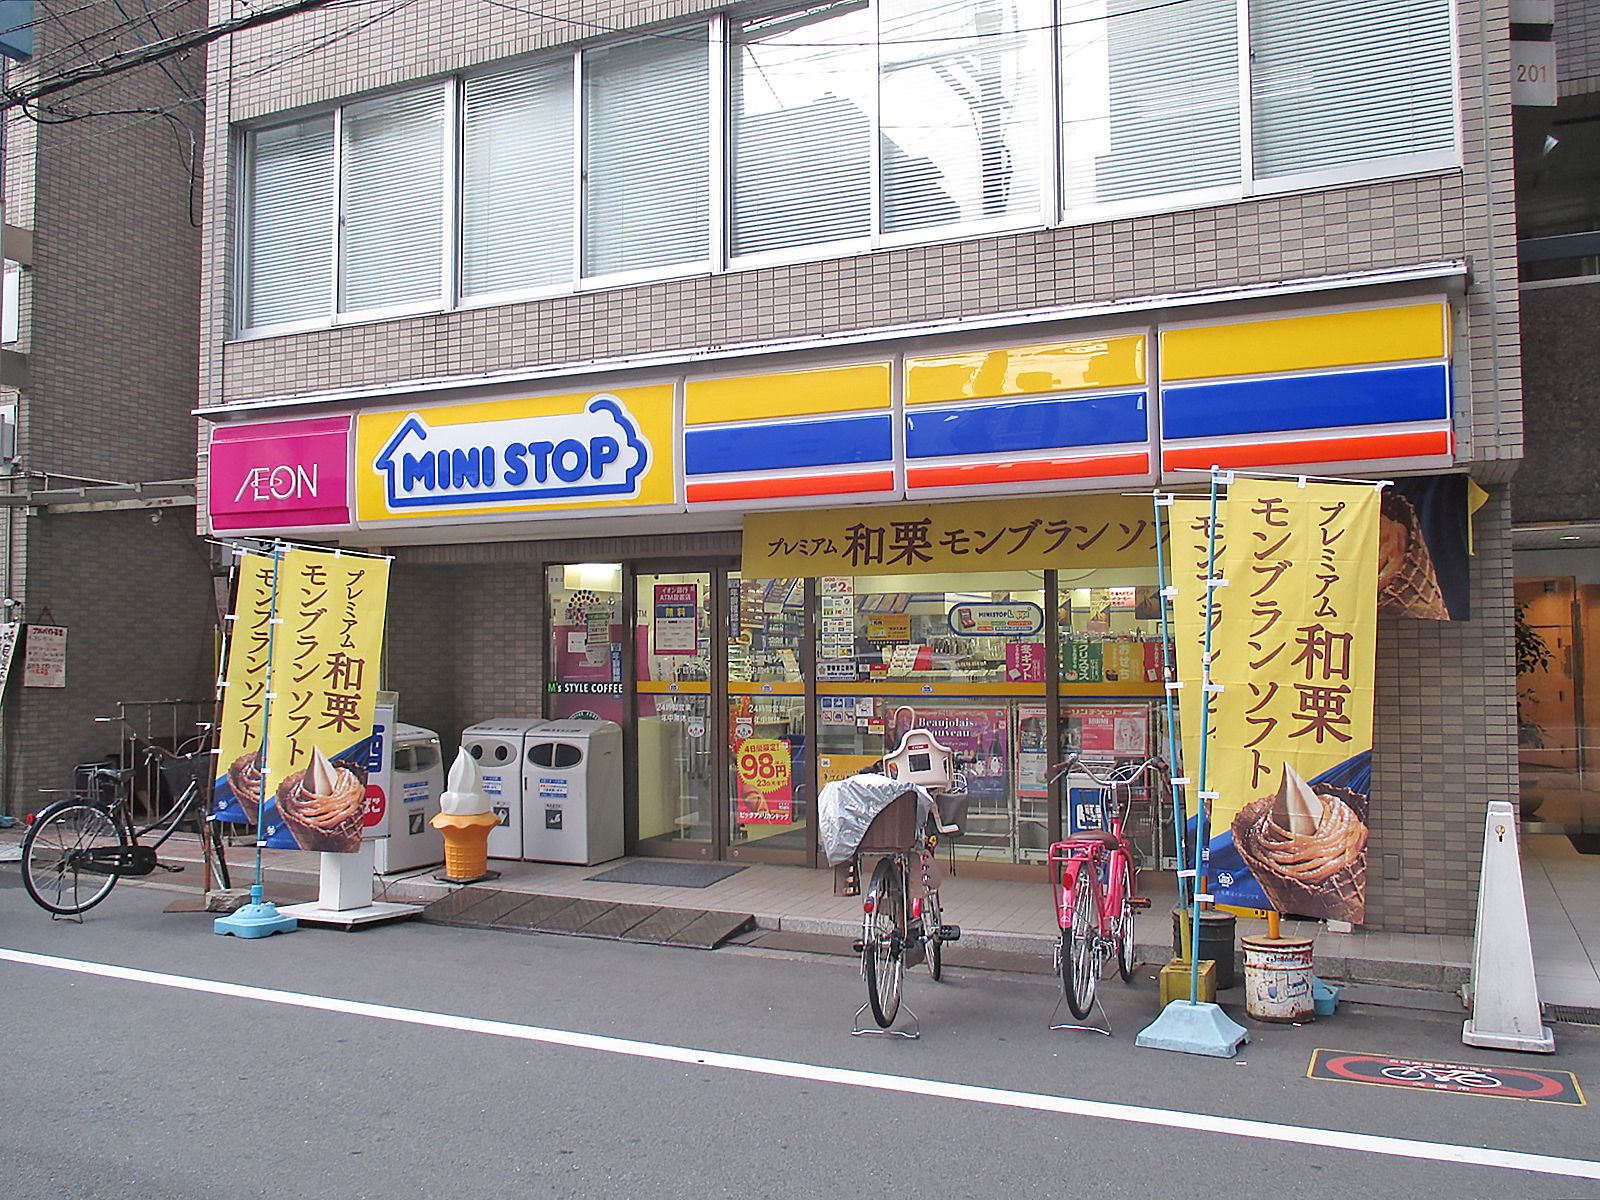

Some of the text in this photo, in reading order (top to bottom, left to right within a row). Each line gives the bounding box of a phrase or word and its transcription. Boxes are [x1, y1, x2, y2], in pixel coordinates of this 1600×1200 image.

[1517, 64, 1547, 83] 201
[1078, 644, 1090, 681] クリスマス
[547, 682, 623, 694] M's STYLE COFFEE
[918, 717, 975, 728] Beaujolais
[931, 729, 970, 737] ouveau
